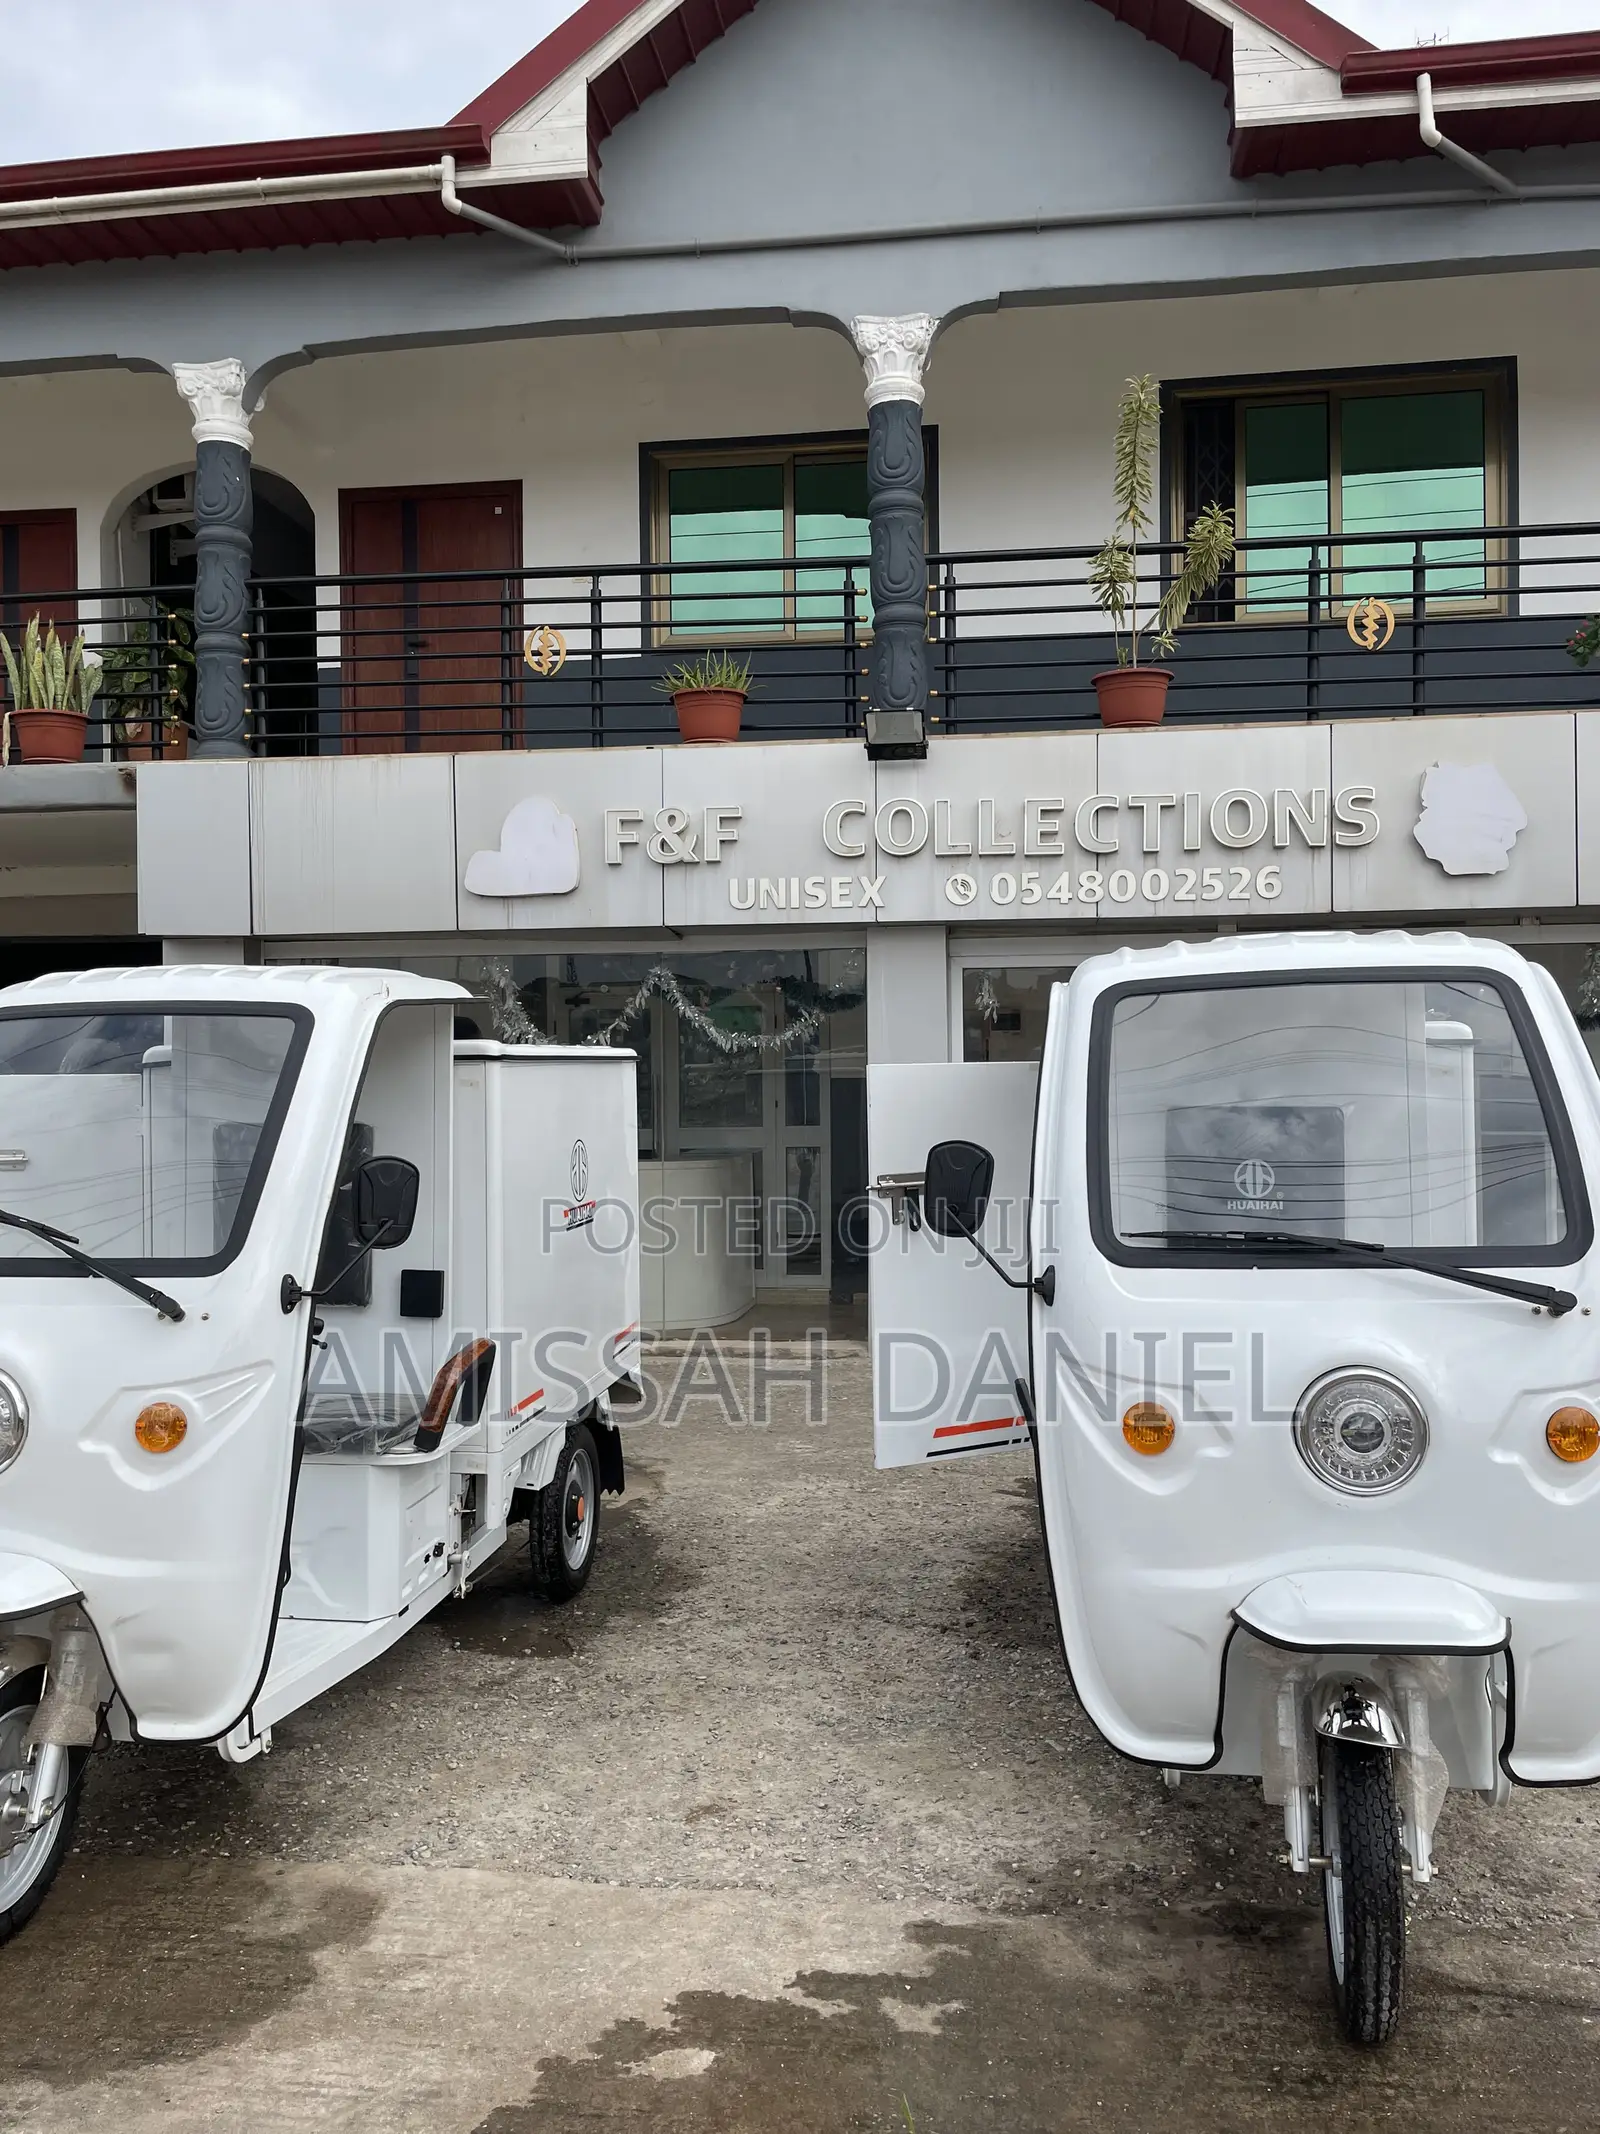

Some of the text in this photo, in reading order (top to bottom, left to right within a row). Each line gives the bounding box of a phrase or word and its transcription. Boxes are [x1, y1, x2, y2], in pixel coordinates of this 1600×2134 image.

[604, 786, 1381, 865] F&F COLLECTIONS
[728, 864, 1283, 910] UNISEX 0548002526
[1227, 1200, 1284, 1210] HUAIHAI
